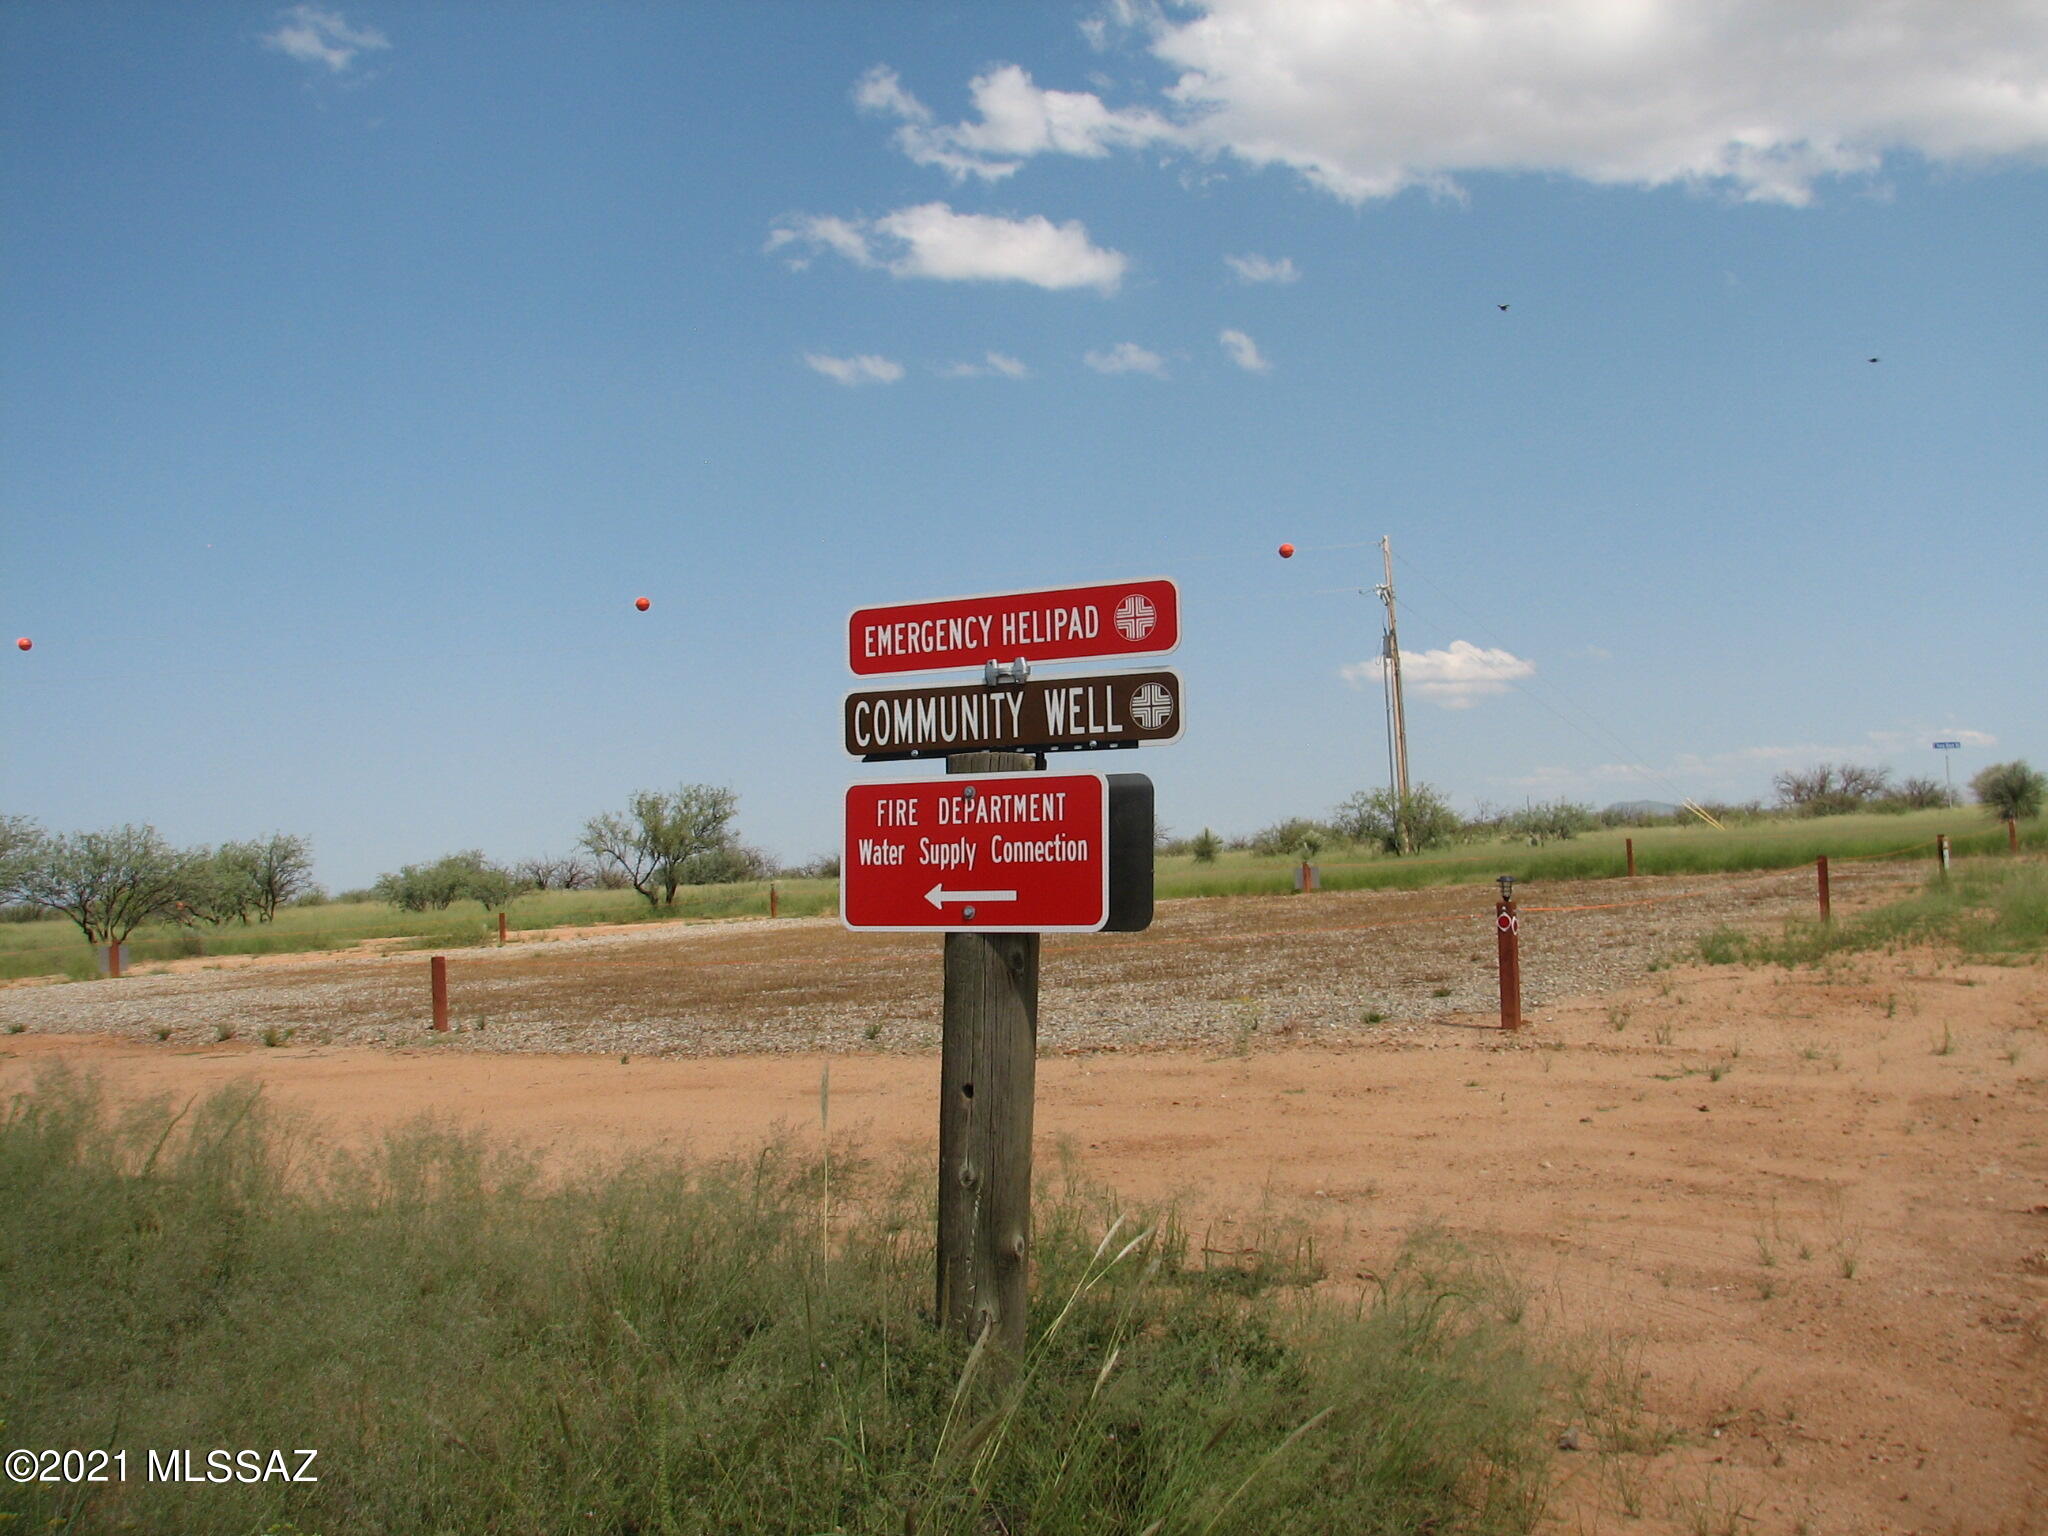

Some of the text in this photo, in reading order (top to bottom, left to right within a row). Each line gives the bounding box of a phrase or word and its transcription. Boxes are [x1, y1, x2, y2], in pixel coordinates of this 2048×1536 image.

[865, 605, 1099, 658] EMERGENCY HELIPAD
[854, 685, 1123, 747] COMMUNITY WELL
[877, 792, 1066, 827] FIRE DEPARTMENT
[858, 833, 1088, 871] Water Supply Connection
